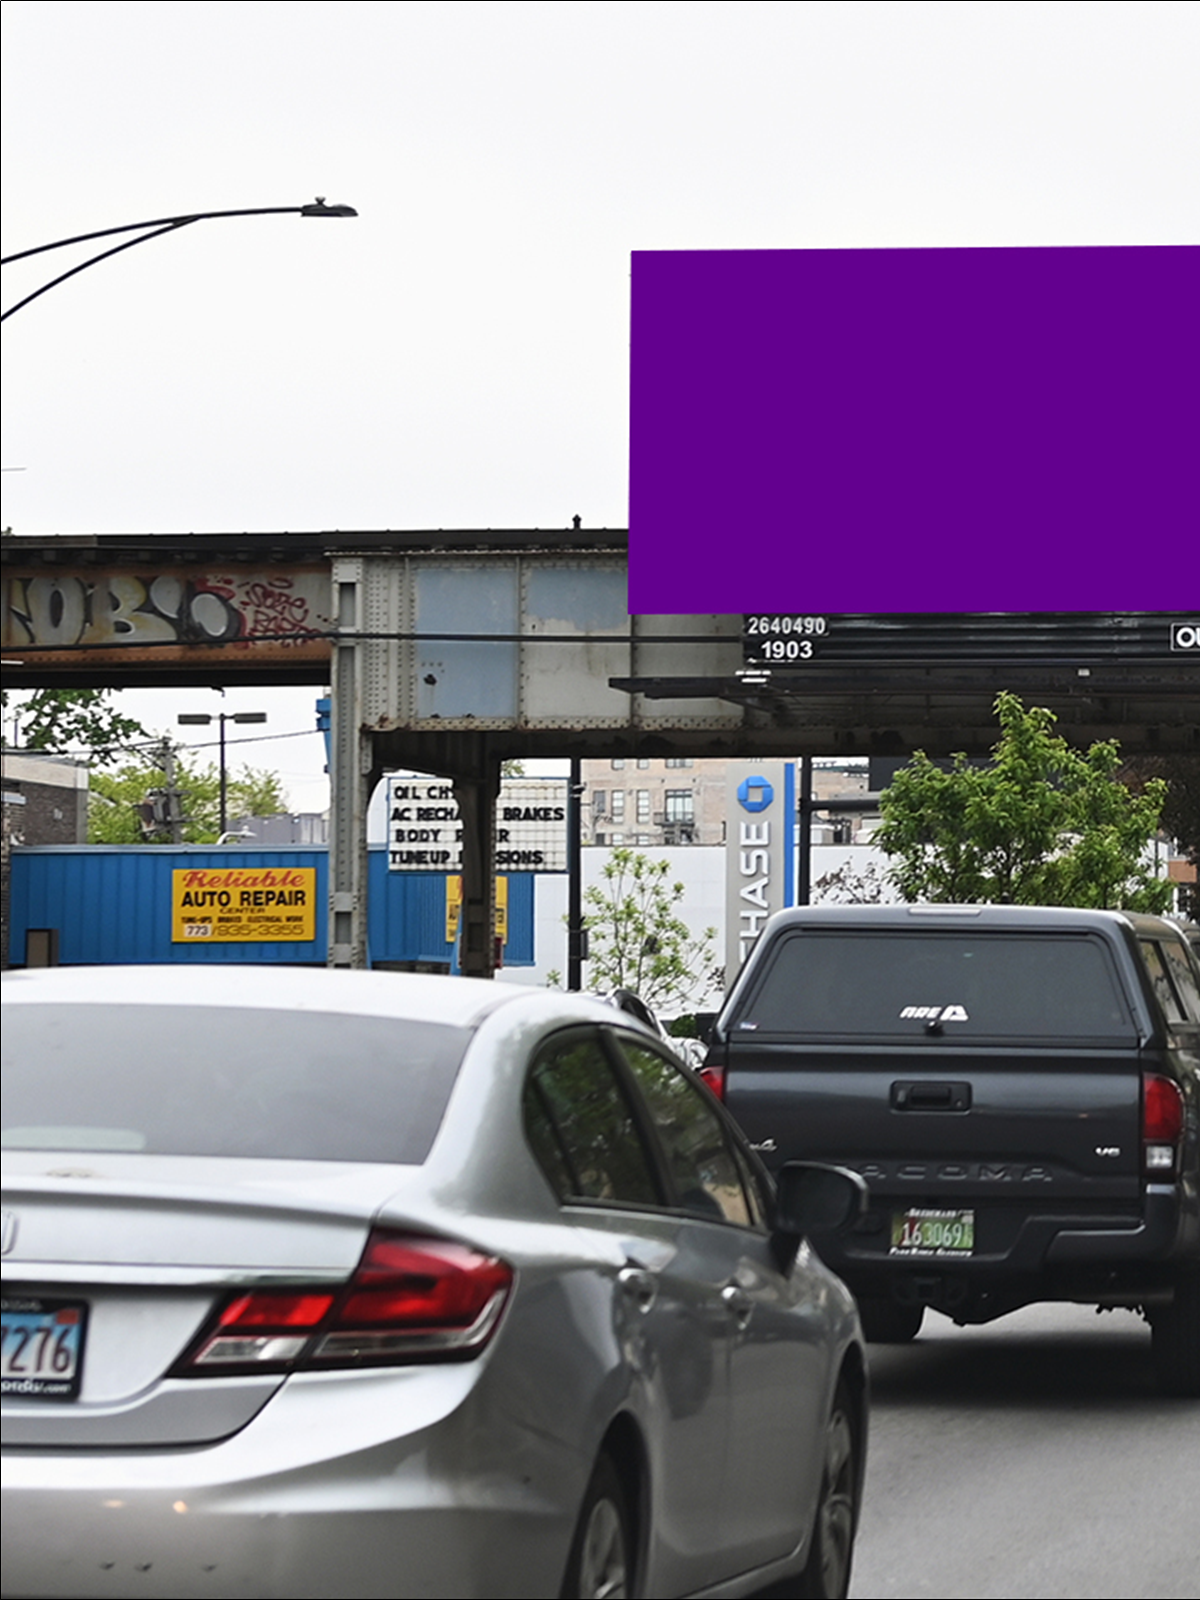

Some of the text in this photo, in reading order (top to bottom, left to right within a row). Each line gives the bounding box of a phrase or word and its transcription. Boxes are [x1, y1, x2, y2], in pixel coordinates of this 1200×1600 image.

[748, 617, 826, 634] 2640490
[761, 641, 813, 659] 1903
[394, 786, 421, 800] OIL
[391, 808, 411, 821] AC
[503, 808, 565, 821] BRAKES
[395, 829, 441, 843] BODY
[389, 851, 450, 864] TUNEUP
[183, 870, 305, 888] Reliable
[181, 890, 306, 907] AUTO REPAIR
[850, 1163, 1054, 1183] ACOMA
[901, 1222, 963, 1248] 163069
